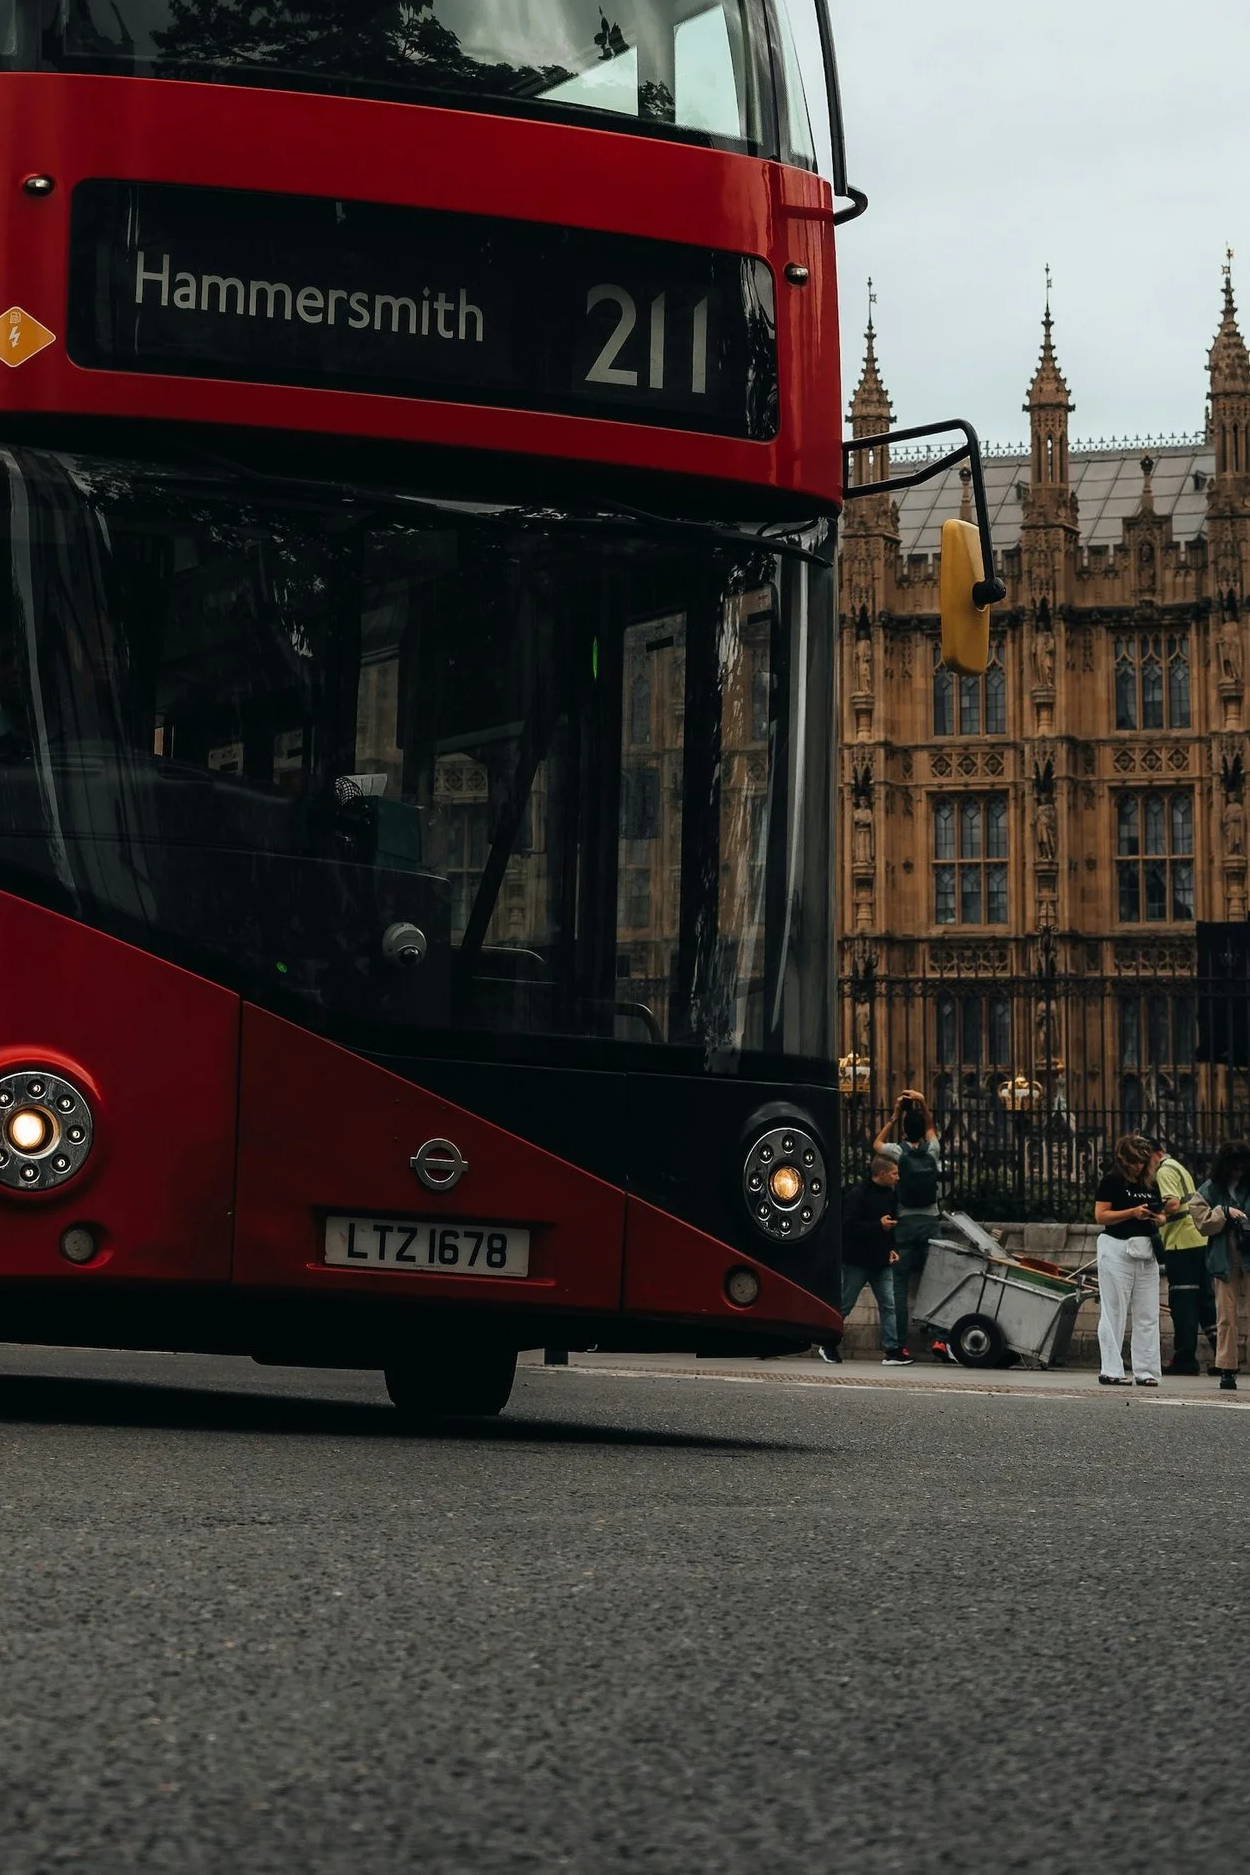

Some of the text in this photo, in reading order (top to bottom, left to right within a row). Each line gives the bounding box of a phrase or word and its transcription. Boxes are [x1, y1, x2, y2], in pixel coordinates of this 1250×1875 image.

[134, 250, 484, 342] Hammersmith
[585, 283, 708, 394] 211
[347, 1222, 508, 1269] LTZ 1678
